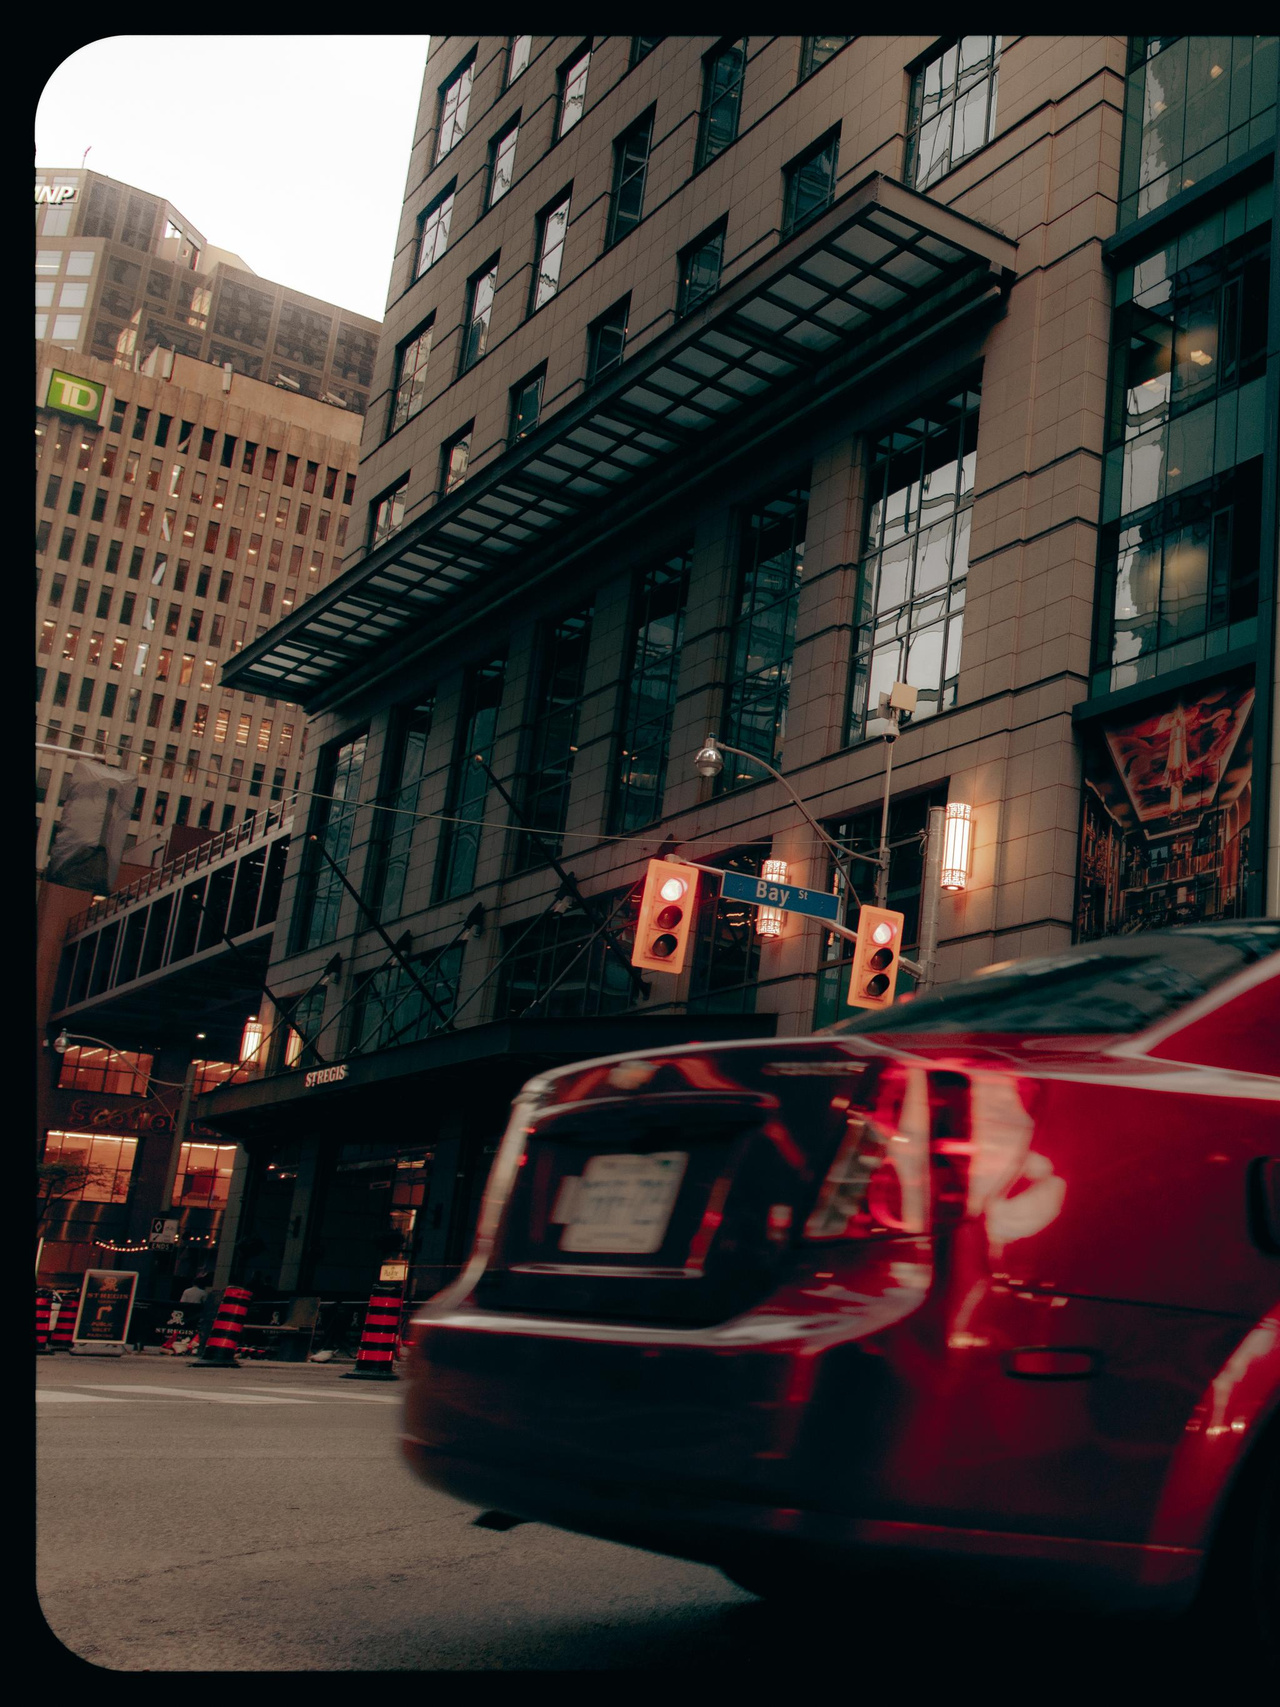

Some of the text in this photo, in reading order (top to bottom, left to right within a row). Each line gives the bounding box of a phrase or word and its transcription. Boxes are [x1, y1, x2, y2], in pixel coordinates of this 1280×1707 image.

[55, 377, 98, 412] TD
[756, 881, 808, 906] Bay St
[317, 1064, 347, 1085] REGIS
